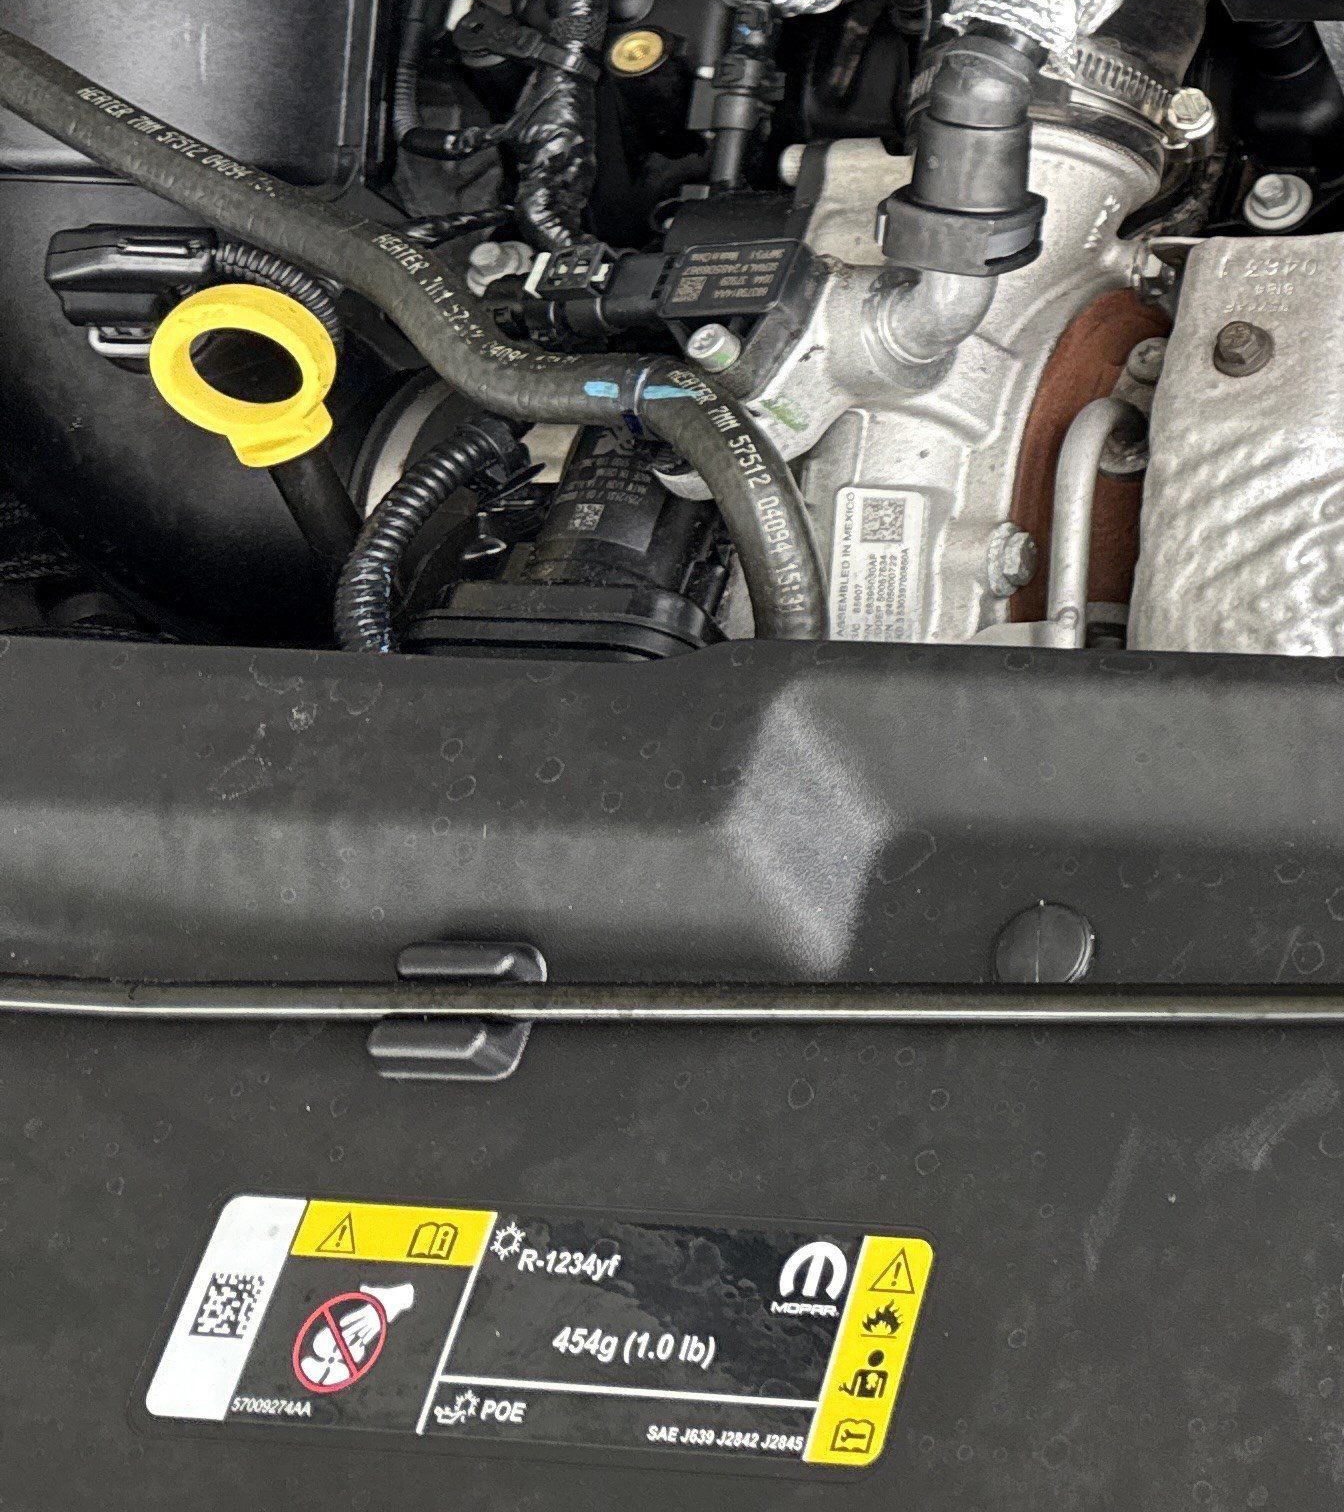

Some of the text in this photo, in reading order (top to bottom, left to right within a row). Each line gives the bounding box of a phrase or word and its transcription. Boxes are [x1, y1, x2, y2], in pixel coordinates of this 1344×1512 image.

[76, 86, 135, 119] HEATER
[126, 115, 166, 135] 7MM
[156, 131, 210, 158] 57512
[371, 233, 430, 275] HEATER
[668, 370, 717, 405] HEATER
[707, 405, 741, 432] 7MM
[728, 435, 771, 489] 57512
[757, 496, 793, 556] 04094
[837, 492, 855, 637] ASSEMBLED IN MEXICO
[517, 1248, 621, 1281] R-1234yf
[770, 1301, 838, 1316] MOPAR
[552, 1326, 716, 1370] 454g (1.0 lb)
[230, 1396, 312, 1418] 57009274AA
[480, 1400, 527, 1423] POE
[646, 1425, 804, 1451] SAE J639 J2842 J2845
